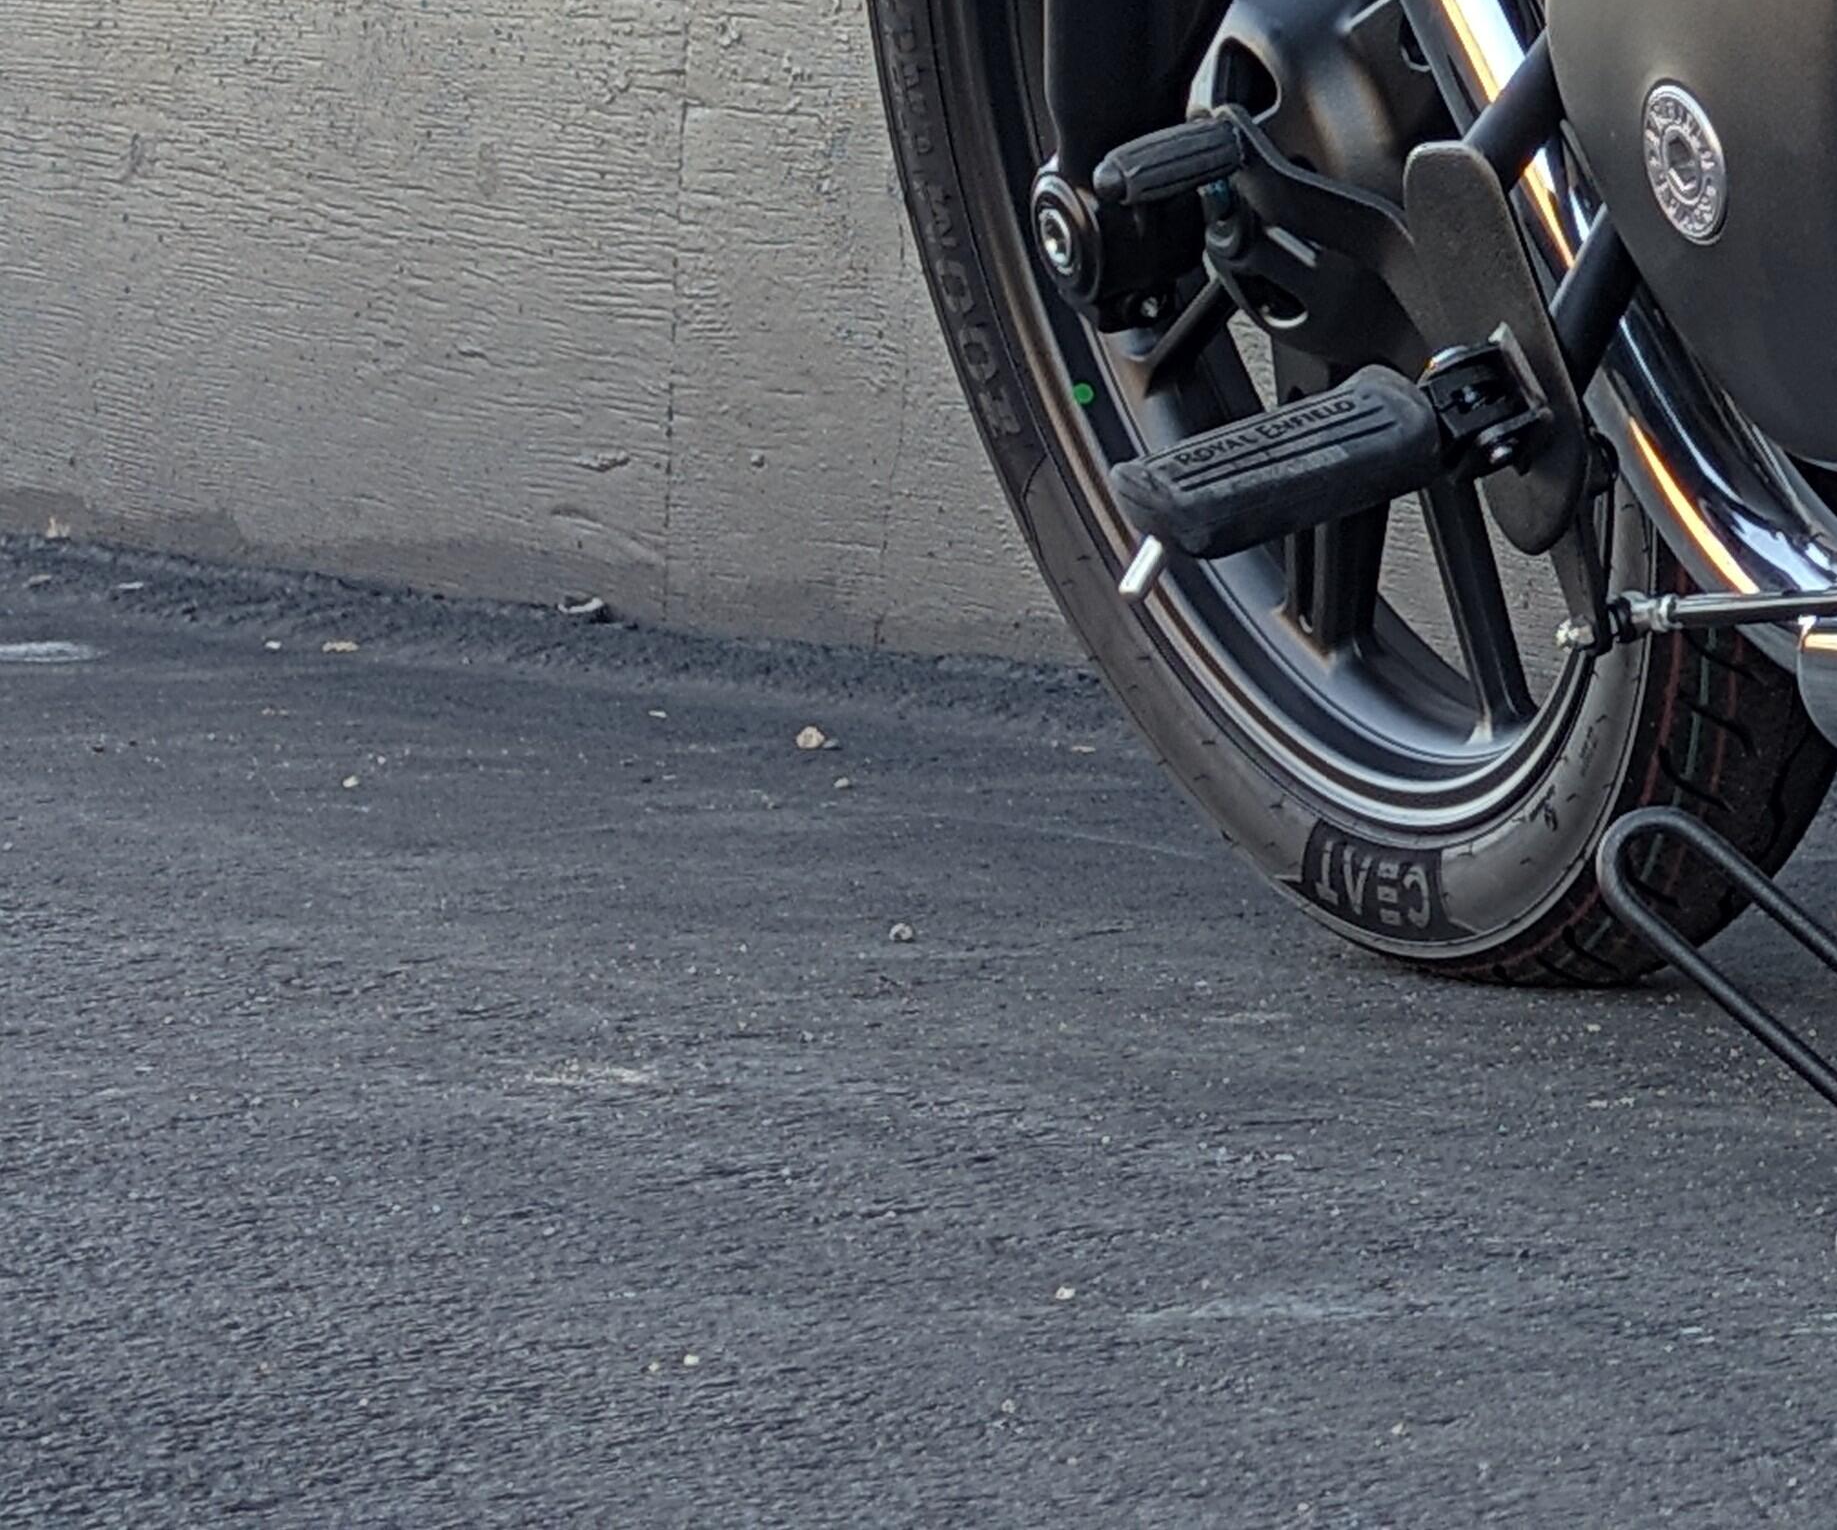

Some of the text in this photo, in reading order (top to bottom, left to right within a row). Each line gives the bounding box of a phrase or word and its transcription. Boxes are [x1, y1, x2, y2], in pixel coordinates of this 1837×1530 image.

[1174, 399, 1356, 466] ROYAL ENFIELD
[1313, 838, 1433, 930] CEAT
